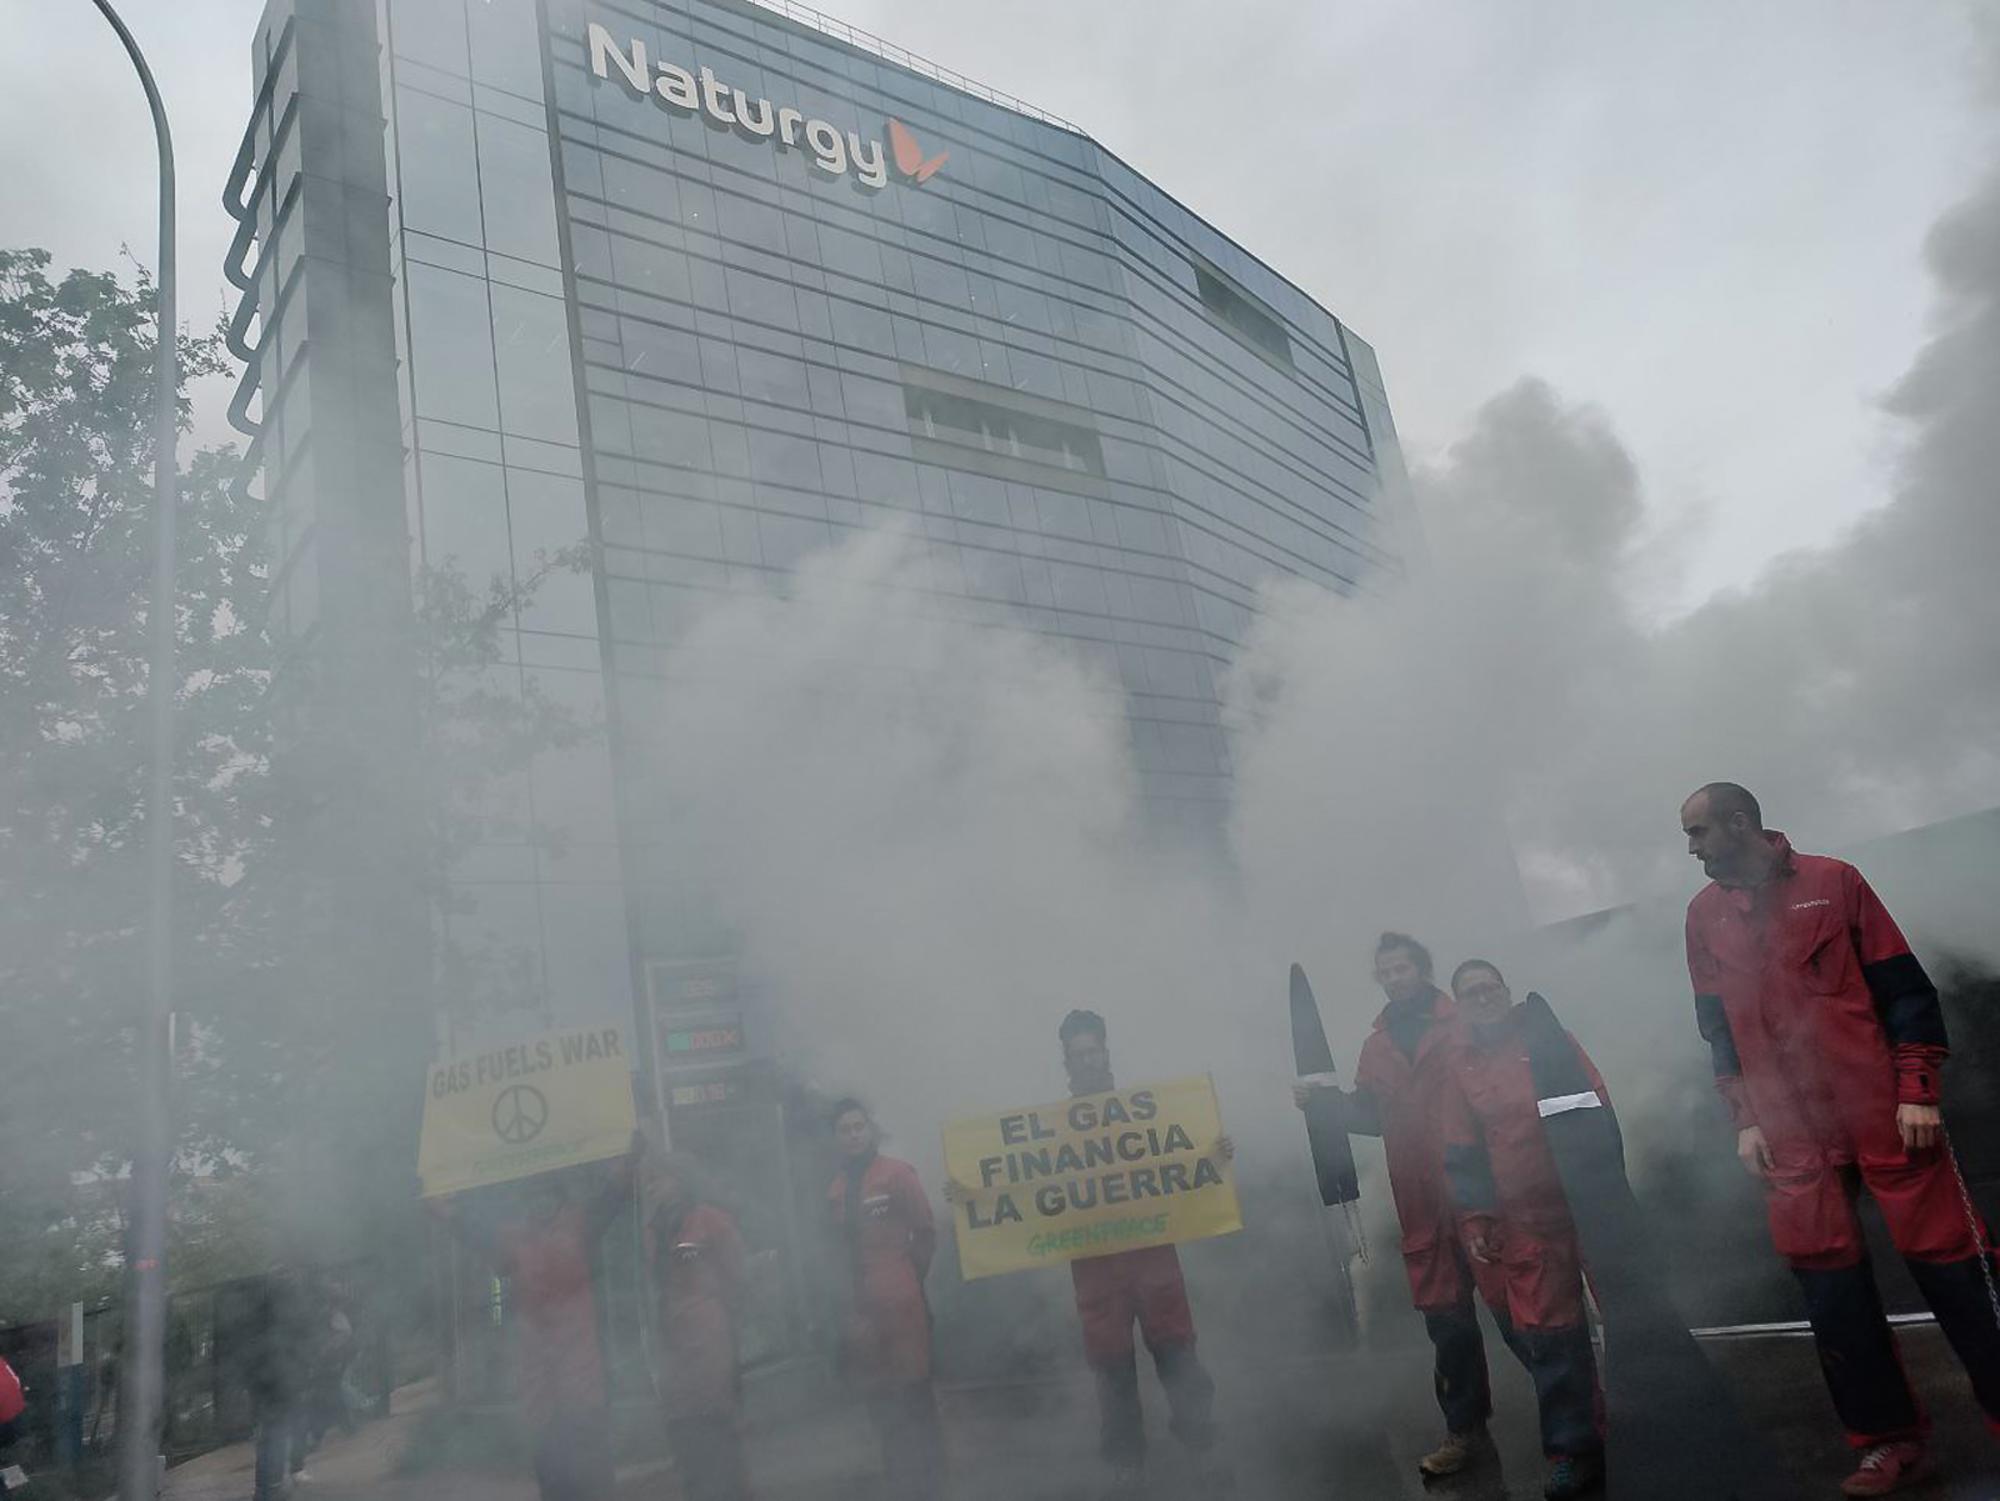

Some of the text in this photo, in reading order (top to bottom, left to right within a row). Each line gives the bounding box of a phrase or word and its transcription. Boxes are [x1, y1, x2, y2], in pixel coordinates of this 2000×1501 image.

[588, 22, 887, 188] Naturgy
[432, 1062, 471, 1099] GAS
[476, 1040, 553, 1085] FUELS
[559, 1028, 622, 1065] WAR
[1000, 1090, 1158, 1146] EL GAS
[979, 1123, 1194, 1188] FINANCIA
[966, 1157, 1223, 1230] LA GUERRA
